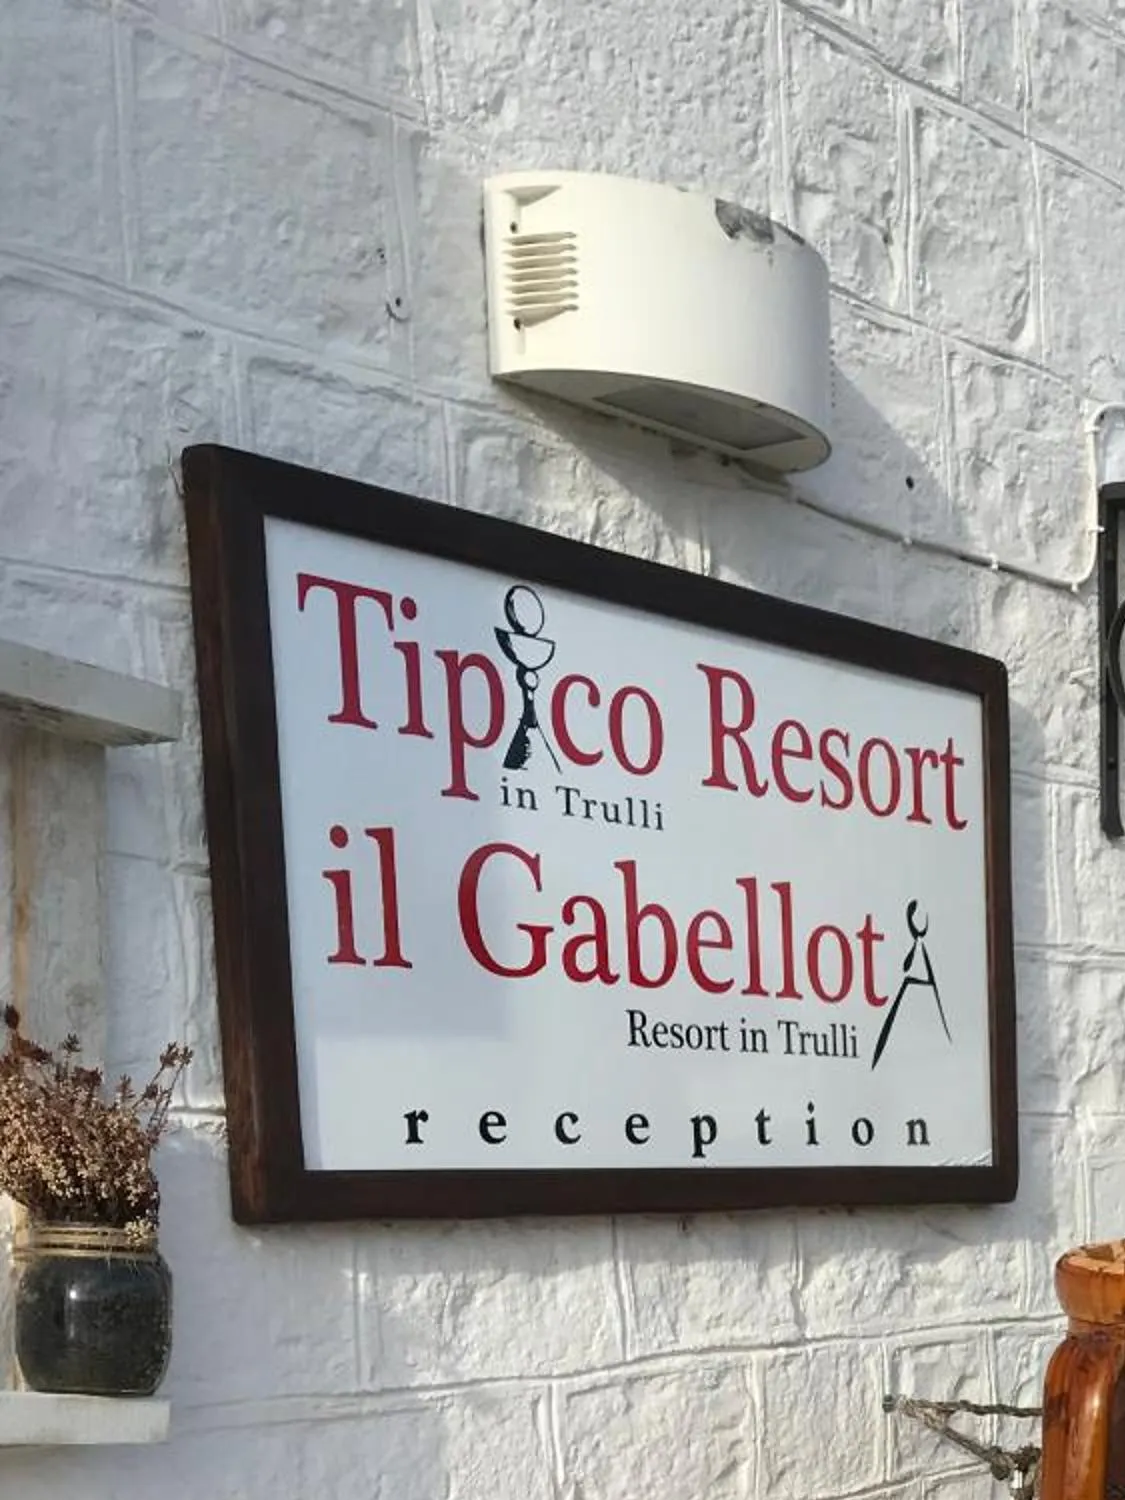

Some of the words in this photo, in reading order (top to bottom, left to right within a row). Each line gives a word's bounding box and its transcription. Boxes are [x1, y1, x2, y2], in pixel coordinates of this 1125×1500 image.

[696, 662, 969, 831] Resort
[499, 776, 539, 811] in
[555, 786, 666, 833] Trulli
[321, 825, 414, 970] il
[625, 1009, 731, 1052] Resort
[739, 1018, 769, 1054] in
[777, 1021, 860, 1061] Trulli
[403, 1101, 931, 1159] reception
